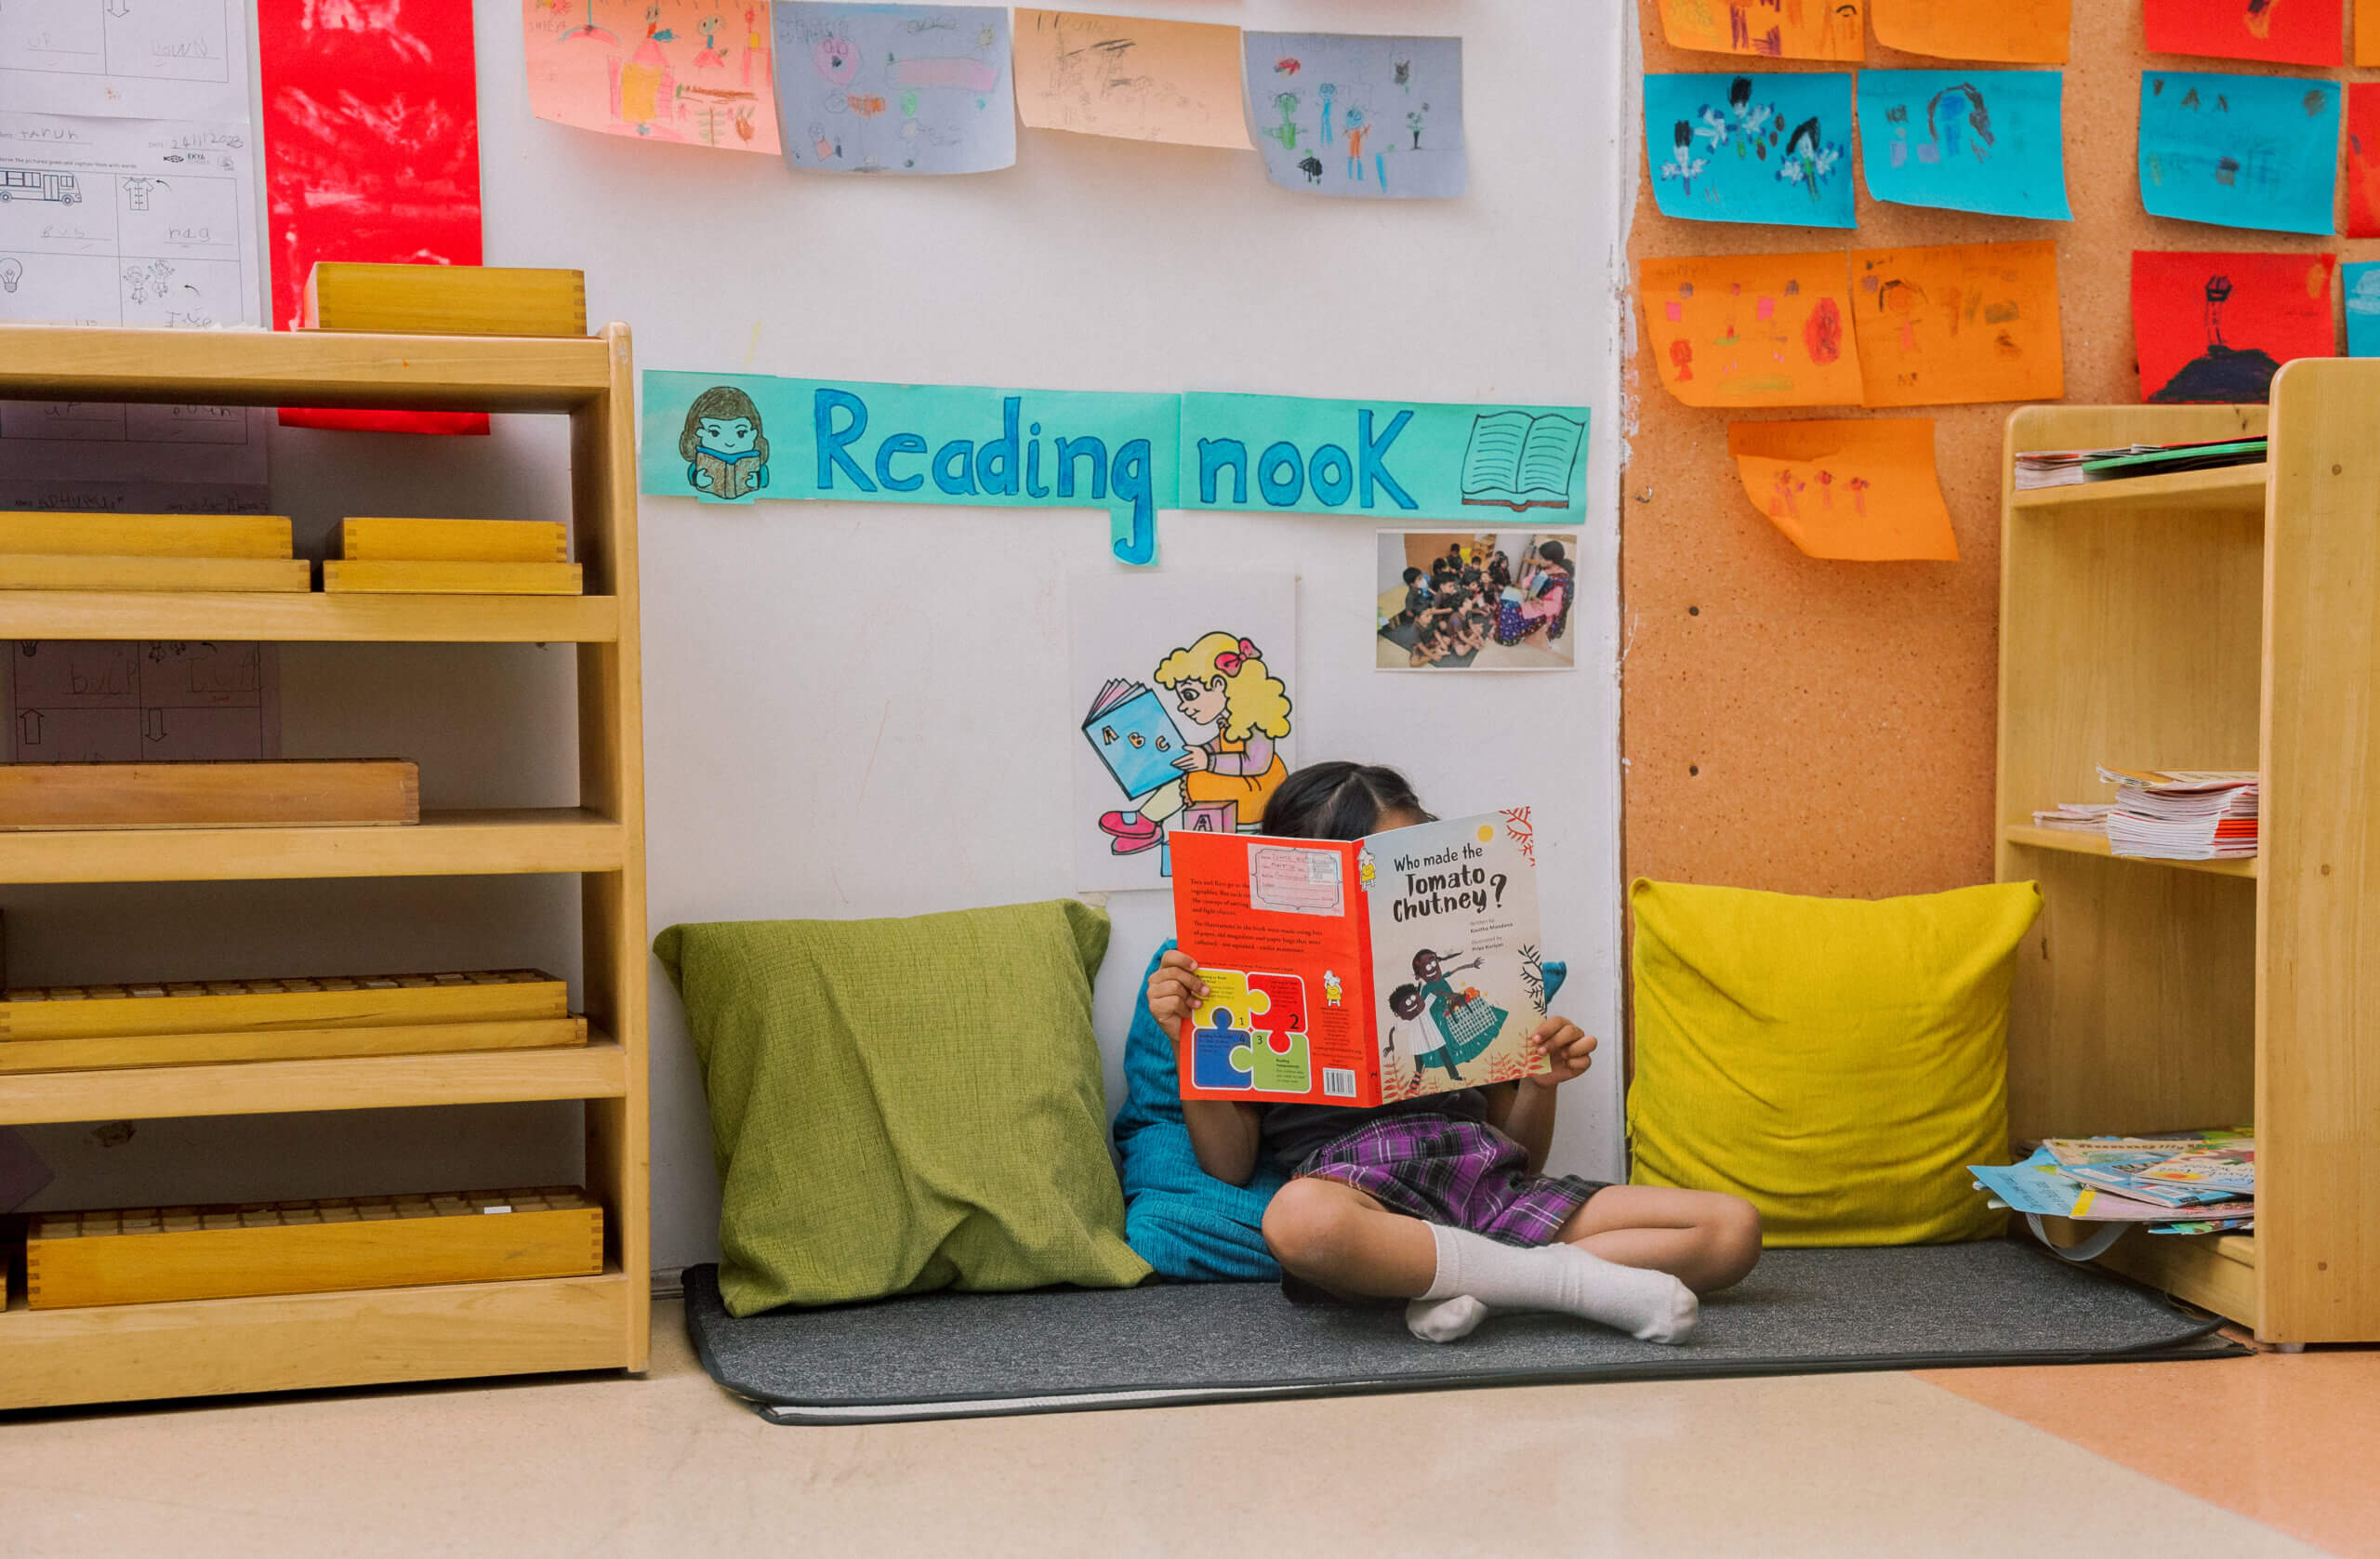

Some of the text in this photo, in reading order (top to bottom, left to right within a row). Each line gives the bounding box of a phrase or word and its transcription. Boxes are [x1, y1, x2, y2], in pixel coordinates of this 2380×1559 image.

[814, 388, 1154, 565] Reading
[1102, 725, 1171, 753] A B C
[1193, 814, 1213, 832] A
[1394, 842, 1483, 873] Who made the
[1405, 865, 1486, 898] Tomato
[1238, 1017, 1244, 1026] 1
[1289, 1013, 1300, 1030] 2
[1238, 1033, 1246, 1043] 4
[1256, 1035, 1263, 1045] 3
